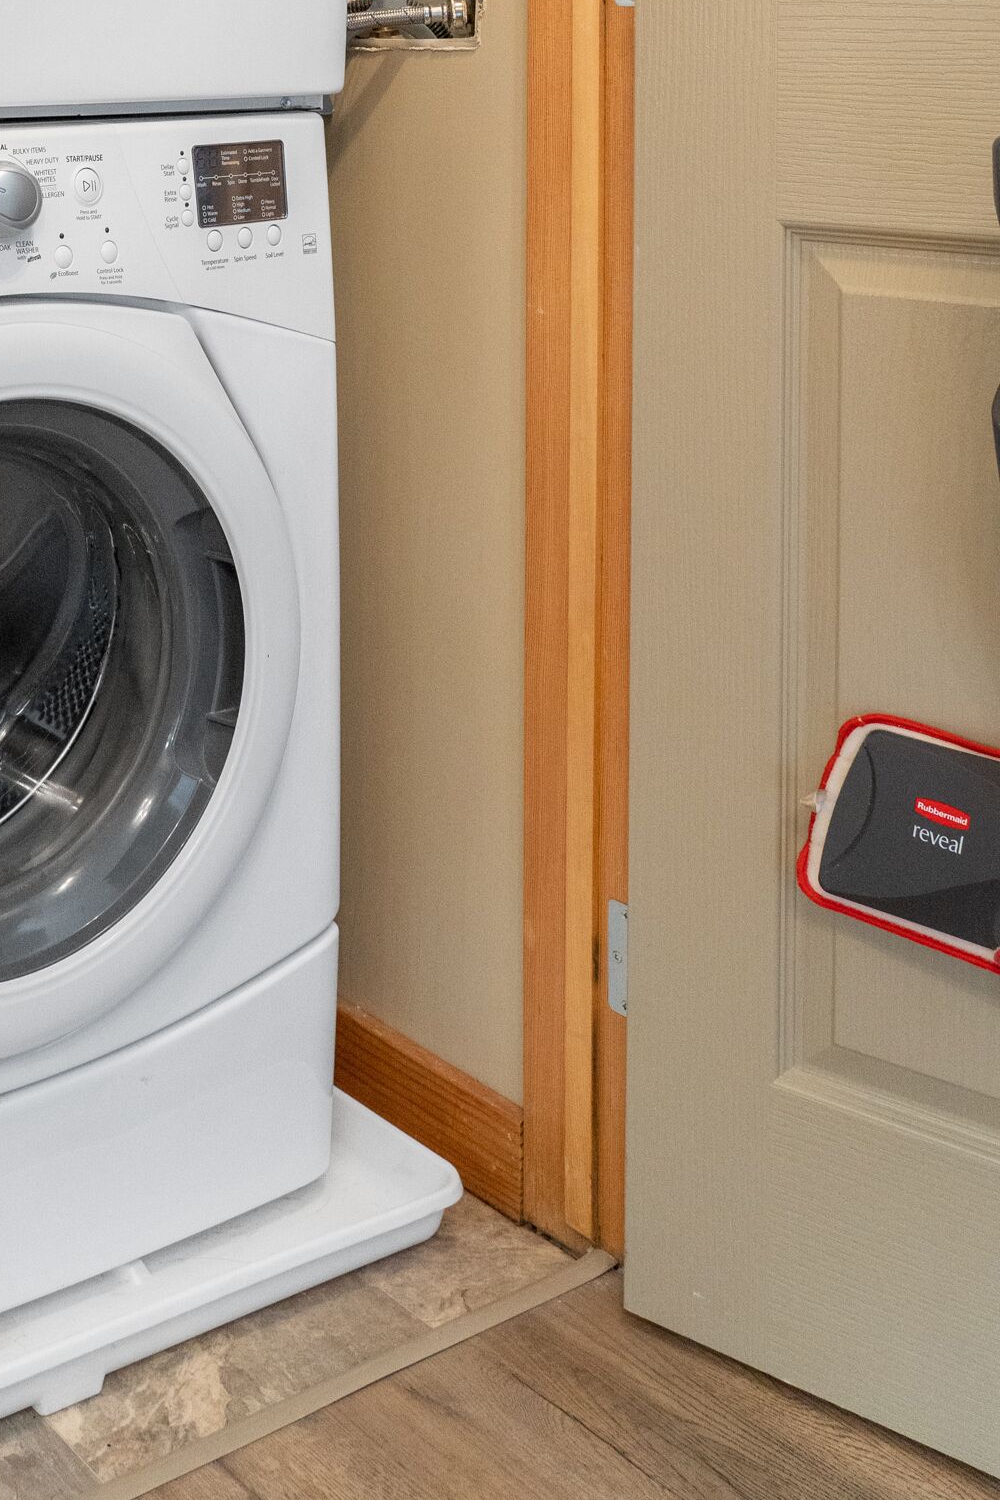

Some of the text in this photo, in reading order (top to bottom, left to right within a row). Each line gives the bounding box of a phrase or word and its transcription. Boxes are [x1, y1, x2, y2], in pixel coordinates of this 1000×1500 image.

[66, 154, 103, 163] START/PAUSE
[166, 215, 178, 223] Cycle
[164, 222, 179, 230] Signal
[15, 240, 34, 248] CLEAN
[201, 258, 229, 266] Temperature
[917, 801, 968, 826] Rubbermaid
[912, 825, 964, 855] reveal
